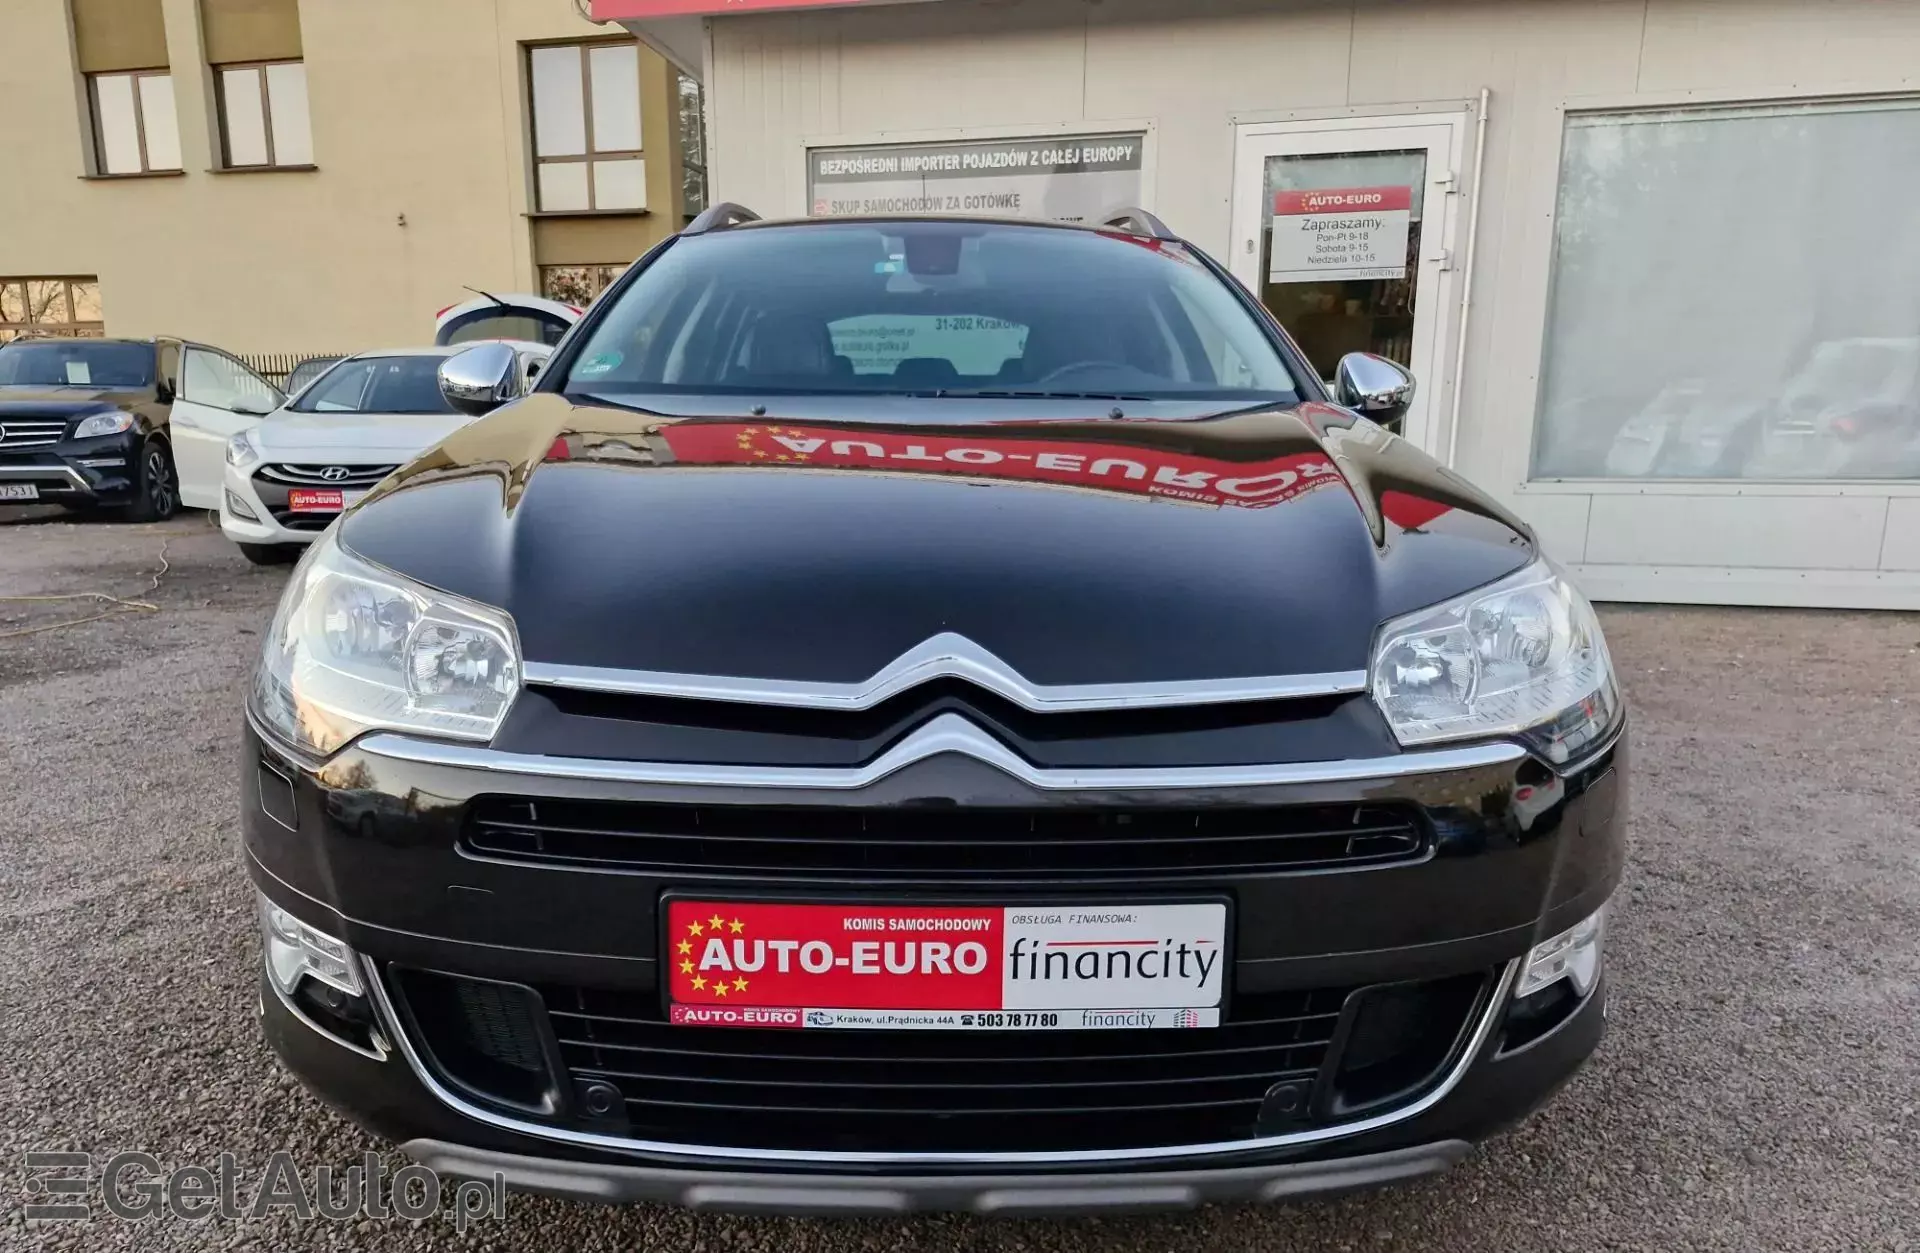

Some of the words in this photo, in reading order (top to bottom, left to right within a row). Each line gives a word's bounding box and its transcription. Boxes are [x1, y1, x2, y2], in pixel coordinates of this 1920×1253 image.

[820, 155, 898, 175] BEZPOŚREDNI
[901, 154, 960, 172] IMPORTER
[963, 149, 1028, 169] POJAZDÓW
[1030, 151, 1039, 166] Z
[1041, 148, 1079, 165] CAŁEJ
[1082, 146, 1133, 163] EUROPY
[831, 200, 860, 214] SKUP
[863, 194, 943, 213] SAMOCHODÓW
[946, 196, 961, 209] ZA
[964, 192, 1021, 211] GOTÓWKĘ
[1309, 194, 1382, 206] AUTO-EURO
[1316, 233, 1347, 242] Pon-Pt
[1348, 232, 1369, 241] 9-18
[1315, 244, 1346, 253] Sobota
[1349, 243, 1369, 252] 9-15
[1307, 255, 1347, 265] Niedziela
[1351, 254, 1376, 263] 10-15
[935, 318, 973, 330] 31-202
[294, 495, 341, 504] AUTO-EURO
[843, 918, 885, 931] KOMIS
[888, 918, 992, 932] SAMOCHODOWY
[1011, 914, 1062, 925] OBSŁUGA
[1068, 913, 1139, 925] FINANSOWA:
[699, 938, 988, 975] AUTO-EURO
[1009, 937, 1218, 989] financity
[683, 1010, 797, 1024] AUTO-EURO
[936, 1016, 955, 1025] 44A
[977, 1013, 1004, 1027] 503
[1082, 1009, 1156, 1029] financity
